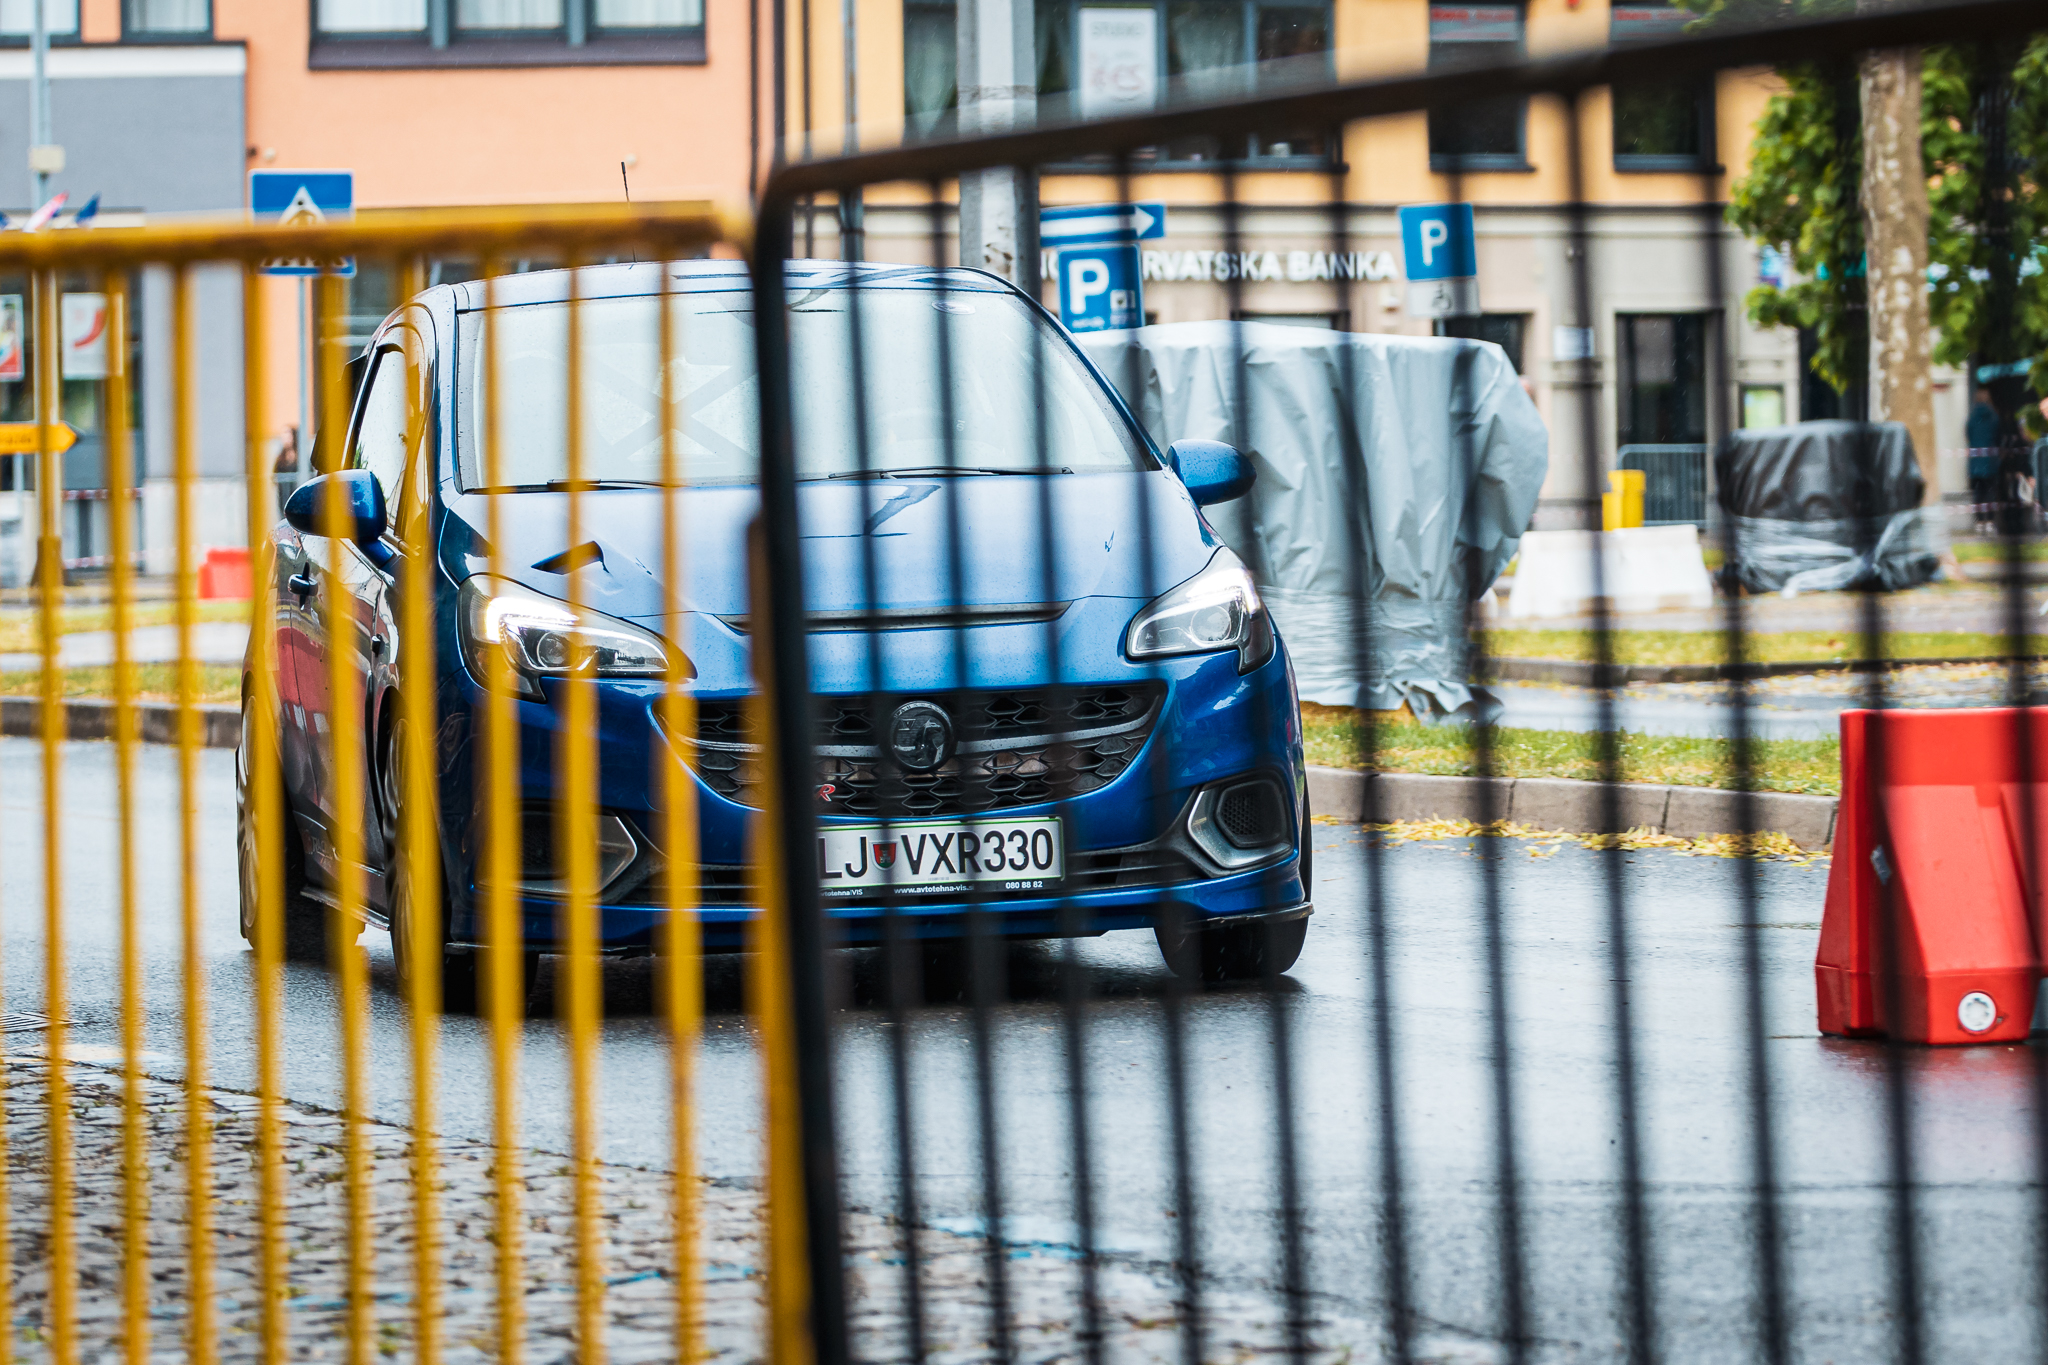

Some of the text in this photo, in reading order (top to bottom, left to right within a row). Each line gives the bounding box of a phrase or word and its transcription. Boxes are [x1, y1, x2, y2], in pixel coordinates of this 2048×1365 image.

[1142, 249, 1398, 282] RVATSKA BANKA
[1420, 219, 1448, 267] P
[1068, 258, 1110, 315] P
[818, 828, 1054, 879] LJ VXR330
[1005, 880, 1043, 890] 080 88 82
